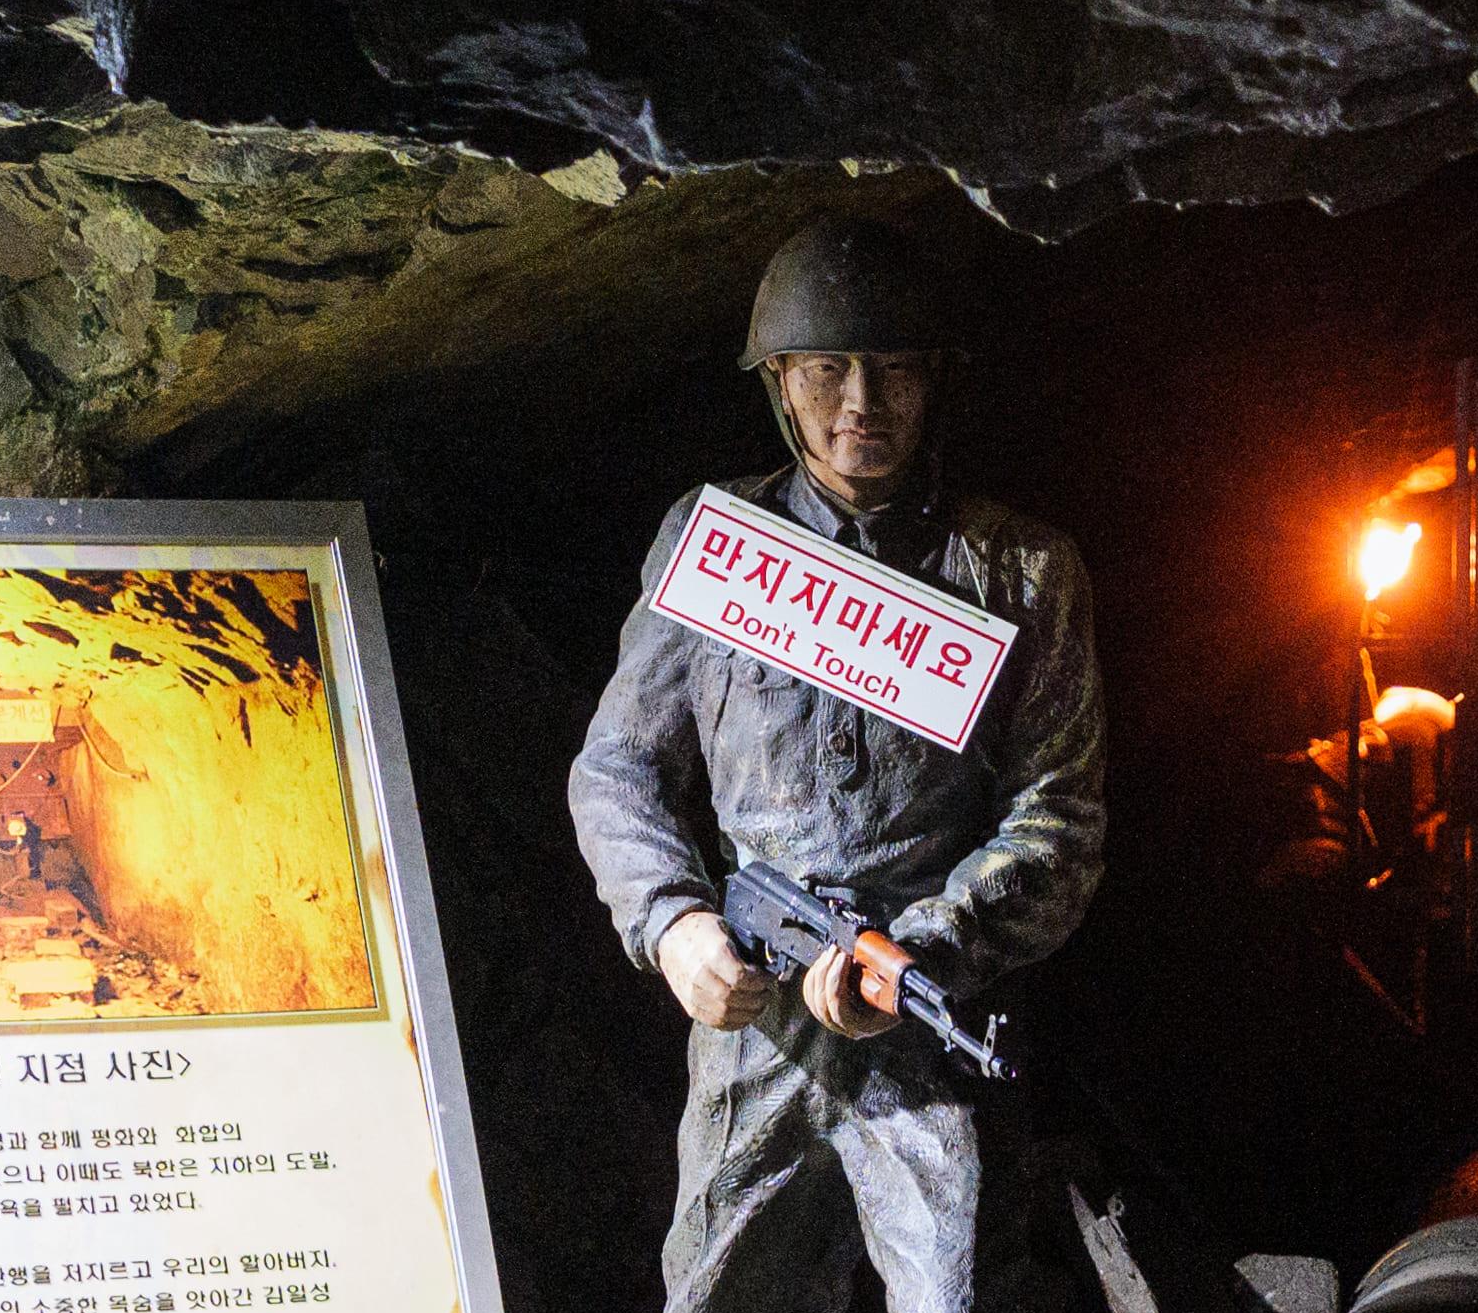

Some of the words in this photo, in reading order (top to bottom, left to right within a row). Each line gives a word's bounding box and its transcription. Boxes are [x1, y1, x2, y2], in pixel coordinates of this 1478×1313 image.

[696, 527, 973, 688] 만지지마세요
[720, 599, 797, 653] Don't
[810, 641, 902, 704] Touch
[18, 1053, 87, 1085] 지점
[37, 1128, 82, 1150] 함께
[91, 1126, 158, 1149] 평화와
[175, 1122, 243, 1144] 화합의
[56, 1161, 123, 1183] 이때도
[132, 1158, 198, 1179] 북한은
[210, 1153, 276, 1175] 지하의
[63, 1259, 153, 1283] 저지르고
[162, 1255, 230, 1278] 우리의
[108, 1291, 176, 1313] 목숨을
[185, 1286, 254, 1310] 앗아간
[262, 1281, 332, 1306] 김일성
